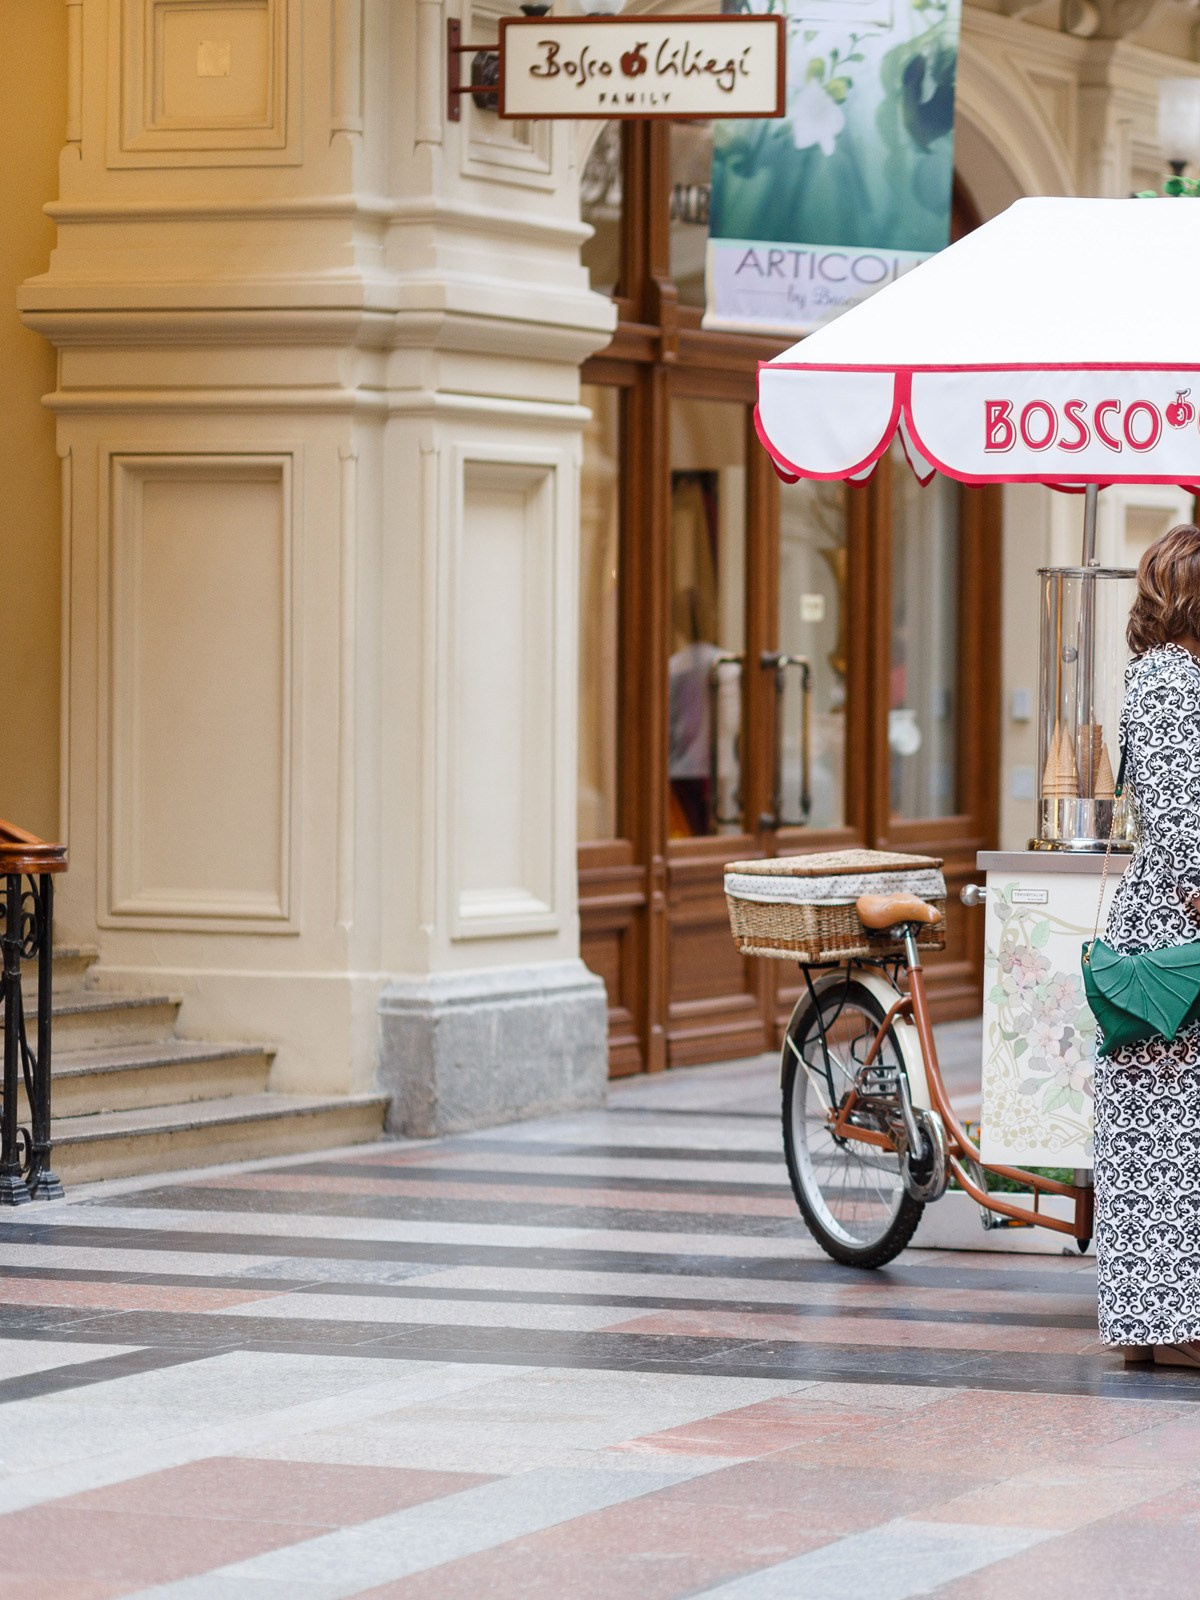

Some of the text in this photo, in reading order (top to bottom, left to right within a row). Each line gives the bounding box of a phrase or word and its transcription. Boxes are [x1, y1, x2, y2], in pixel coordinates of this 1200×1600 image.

[529, 40, 612, 88] Bosco
[598, 91, 672, 106] FAMILY
[735, 248, 923, 284] ARTICOL
[984, 399, 1163, 454] BOSCO
